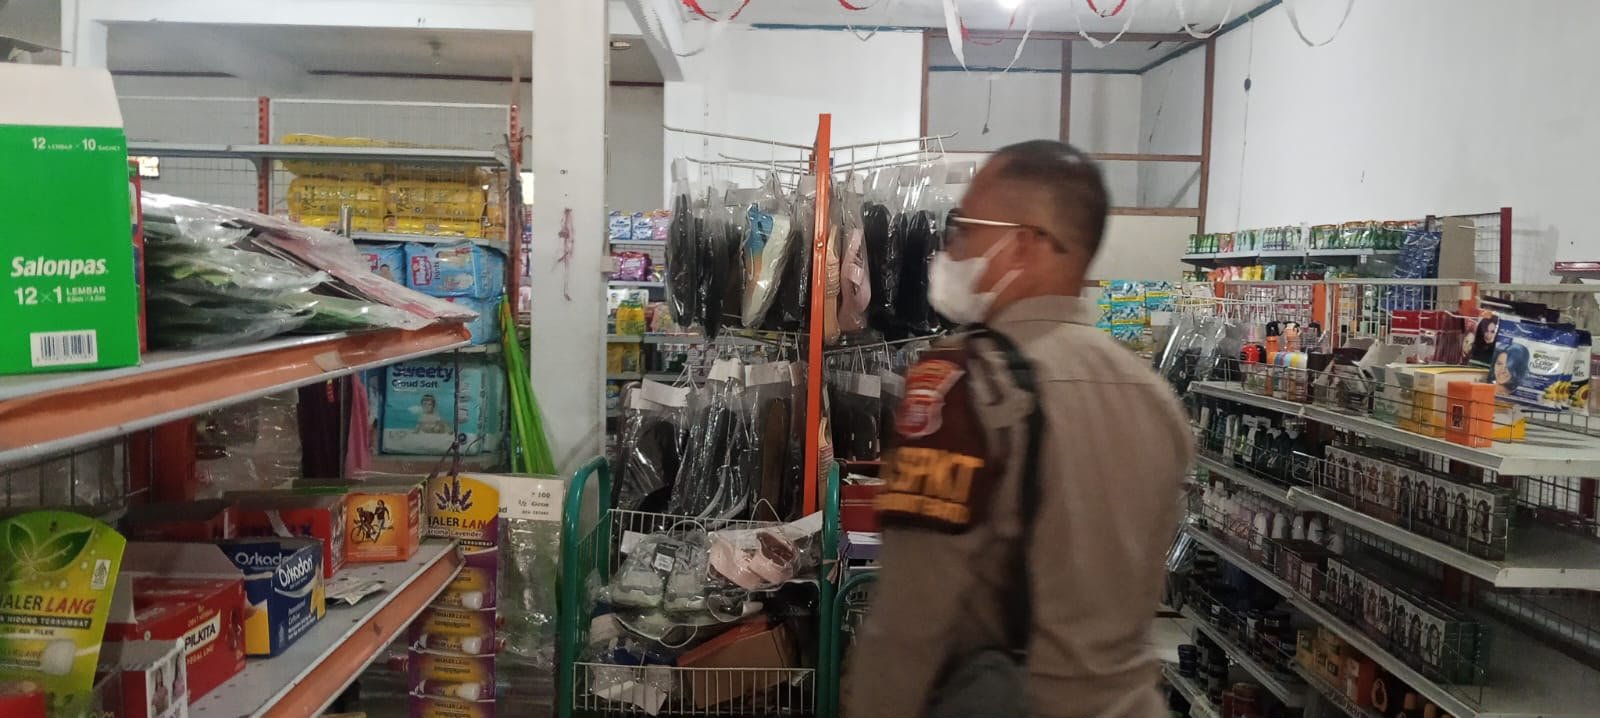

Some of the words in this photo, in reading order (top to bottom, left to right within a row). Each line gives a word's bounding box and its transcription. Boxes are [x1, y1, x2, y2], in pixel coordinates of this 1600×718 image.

[31, 136, 47, 150] 12
[82, 138, 97, 151] 10
[10, 255, 107, 280] Salonpas
[14, 286, 39, 305] 12
[53, 285, 63, 304] 1
[66, 286, 106, 296] LEMBAR
[392, 362, 454, 382] Sweety
[420, 379, 439, 389] Soft
[461, 519, 492, 531] LAN
[278, 554, 313, 588] Oskadon
[44, 597, 97, 616] LANG
[7, 615, 39, 626] HIDUNG
[41, 618, 90, 629] TERSUMBAT
[184, 623, 216, 651] PILKITA
